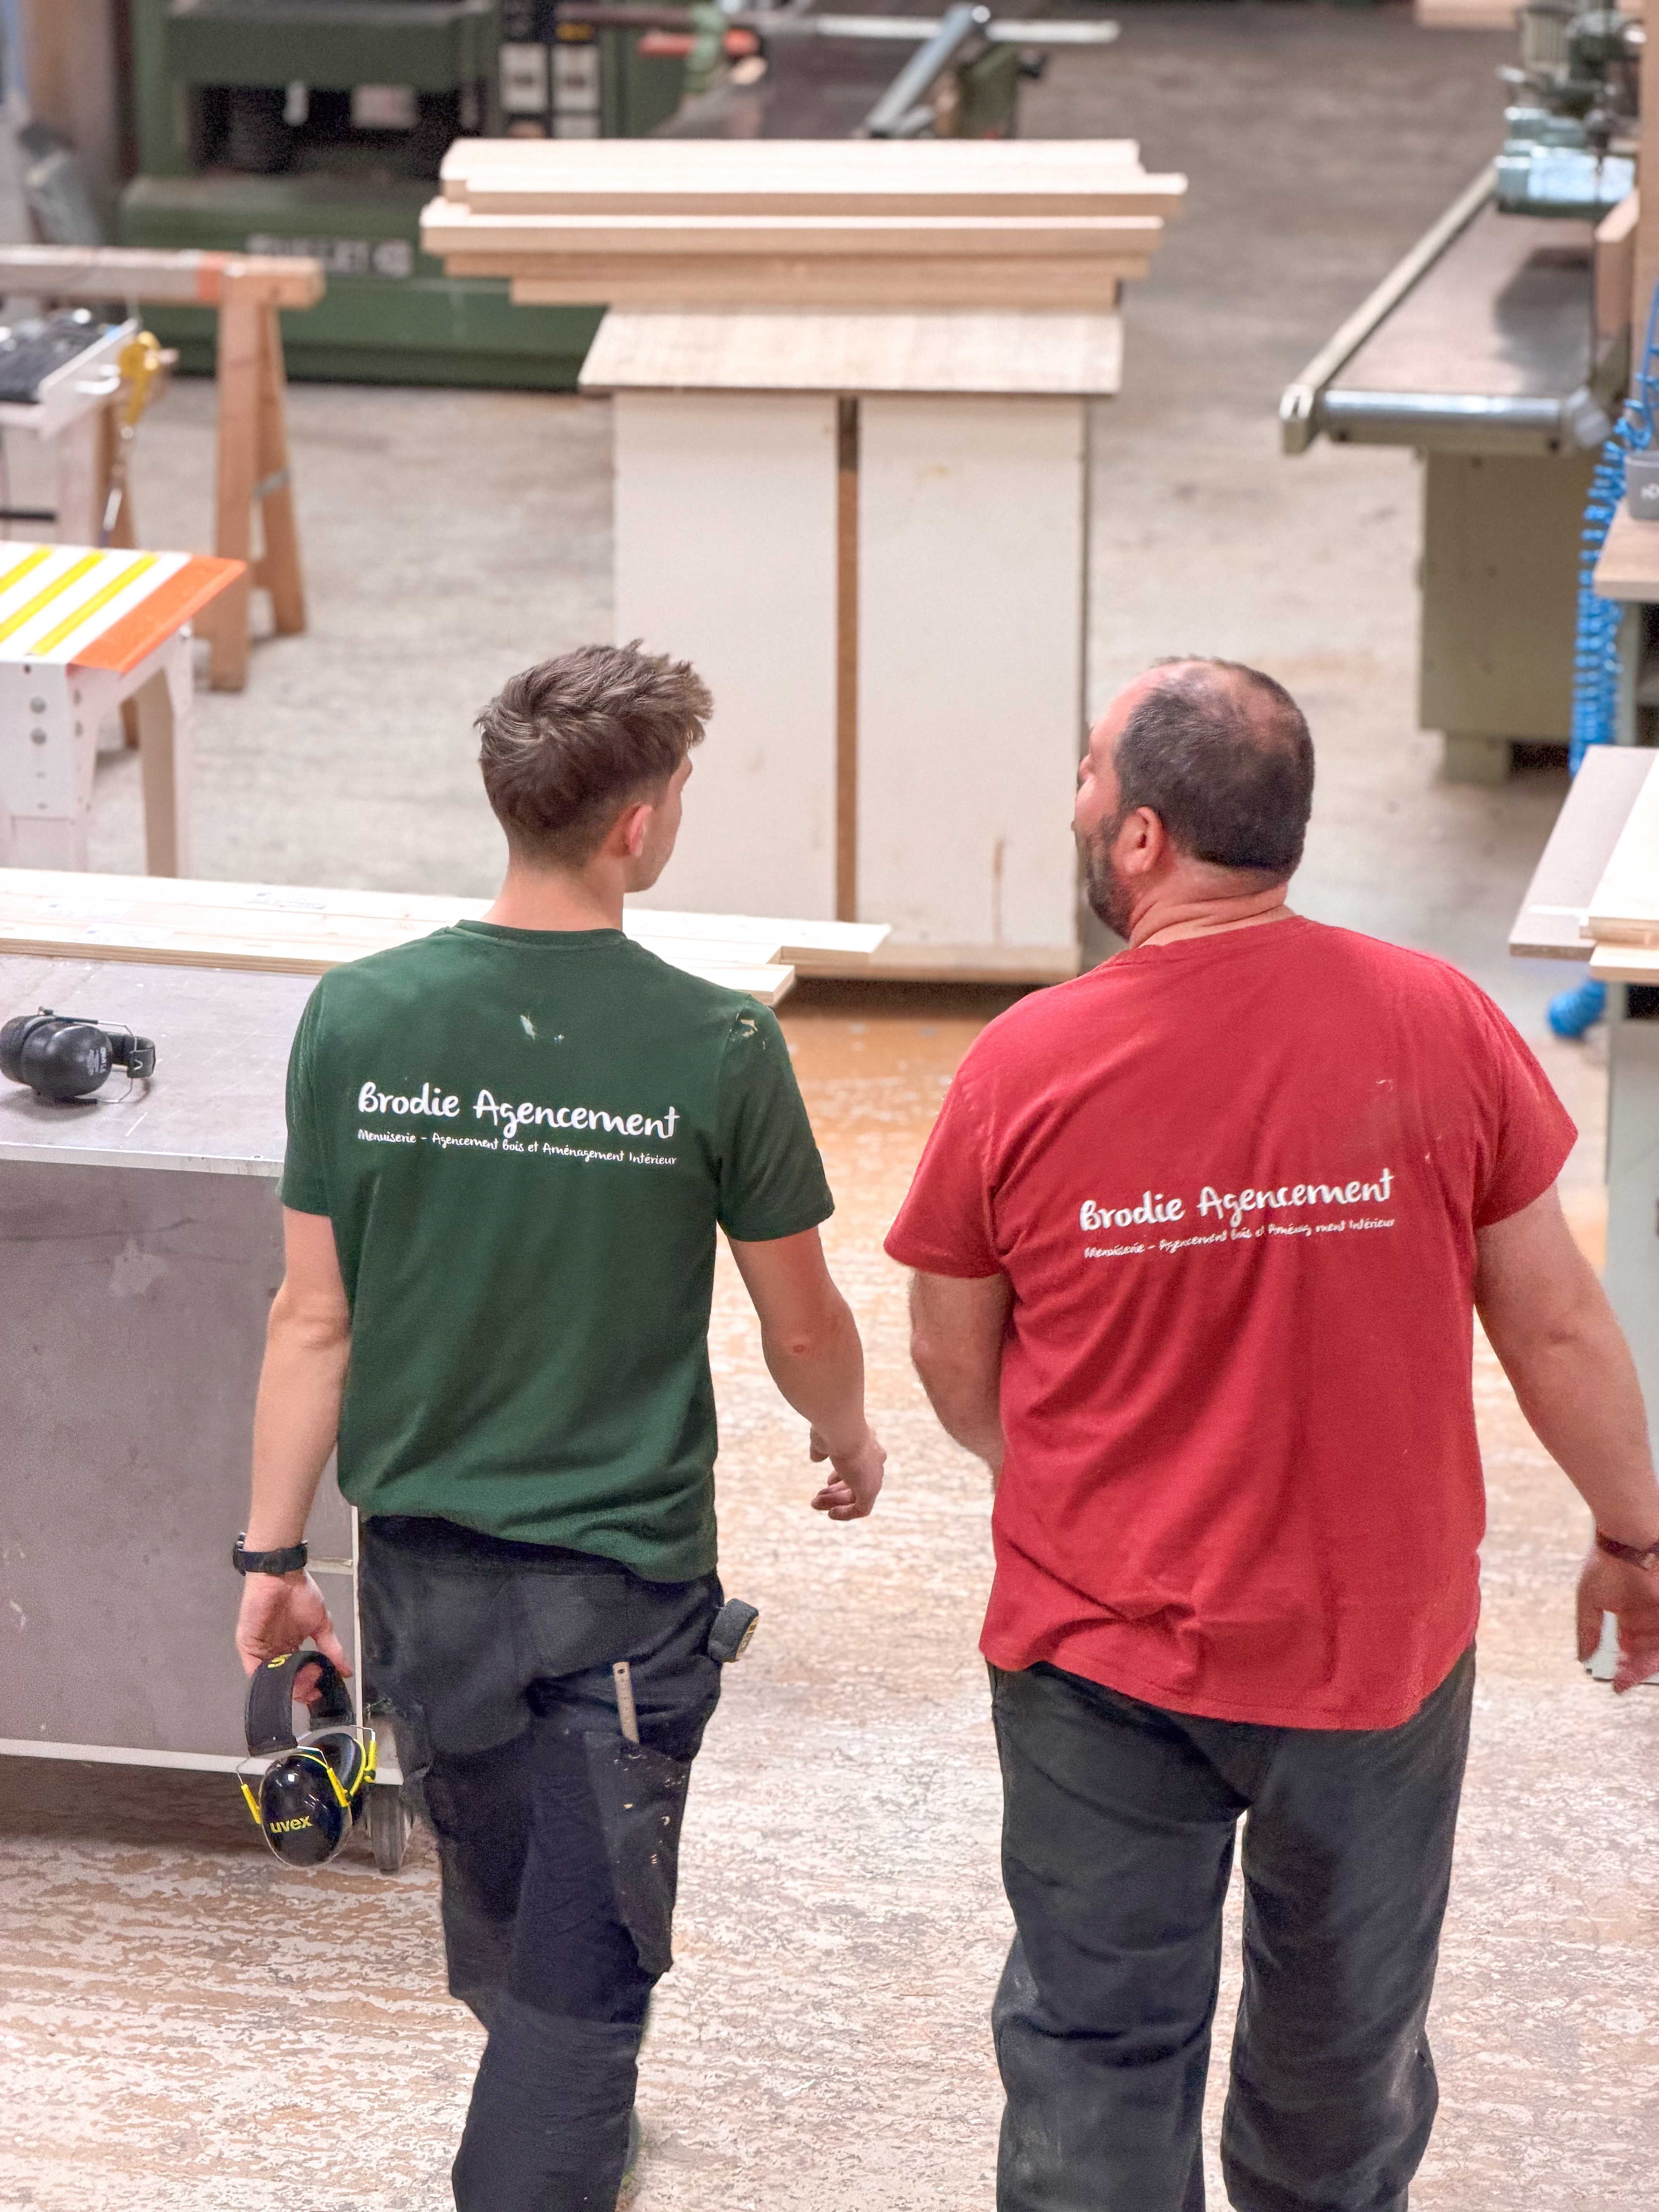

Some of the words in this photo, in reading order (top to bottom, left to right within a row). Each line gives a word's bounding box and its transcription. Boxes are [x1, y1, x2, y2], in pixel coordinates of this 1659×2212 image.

[358, 1082, 460, 1117] Brodie
[473, 1089, 680, 1139] Agencement
[357, 1129, 417, 1143] Menuiserie
[432, 1132, 499, 1149] Agencement
[528, 1141, 538, 1152] et
[542, 1142, 624, 1162] Aménagement
[629, 1152, 677, 1165] Intérieur
[1080, 1190, 1185, 1231] Brodie
[1196, 1168, 1395, 1228] Agencement
[270, 1815, 313, 1833] uvex
